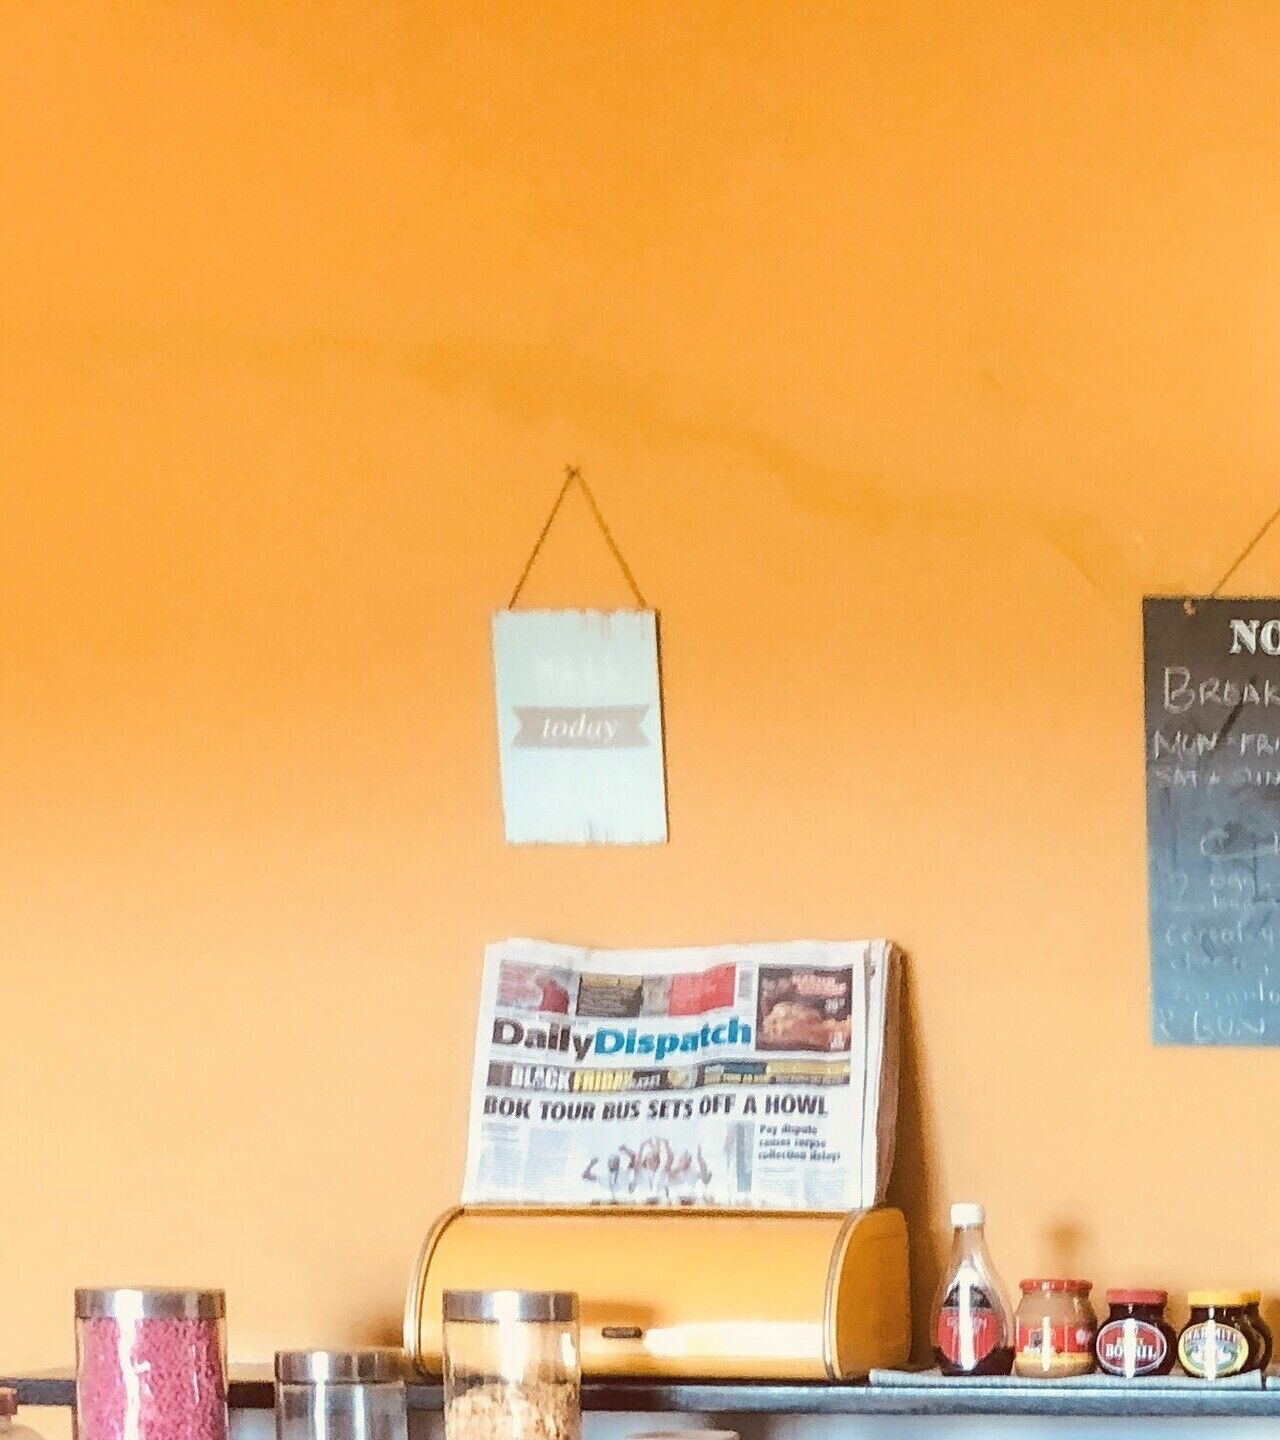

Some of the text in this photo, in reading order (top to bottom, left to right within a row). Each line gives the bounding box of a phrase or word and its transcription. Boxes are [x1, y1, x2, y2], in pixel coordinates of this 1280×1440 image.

[542, 711, 618, 745] today
[540, 1101, 596, 1121] TOUR
[602, 1101, 641, 1120] BUS
[648, 1099, 693, 1120] SETS
[699, 1094, 736, 1115] OFF
[743, 1095, 757, 1114] A
[765, 1093, 828, 1115] HOWL
